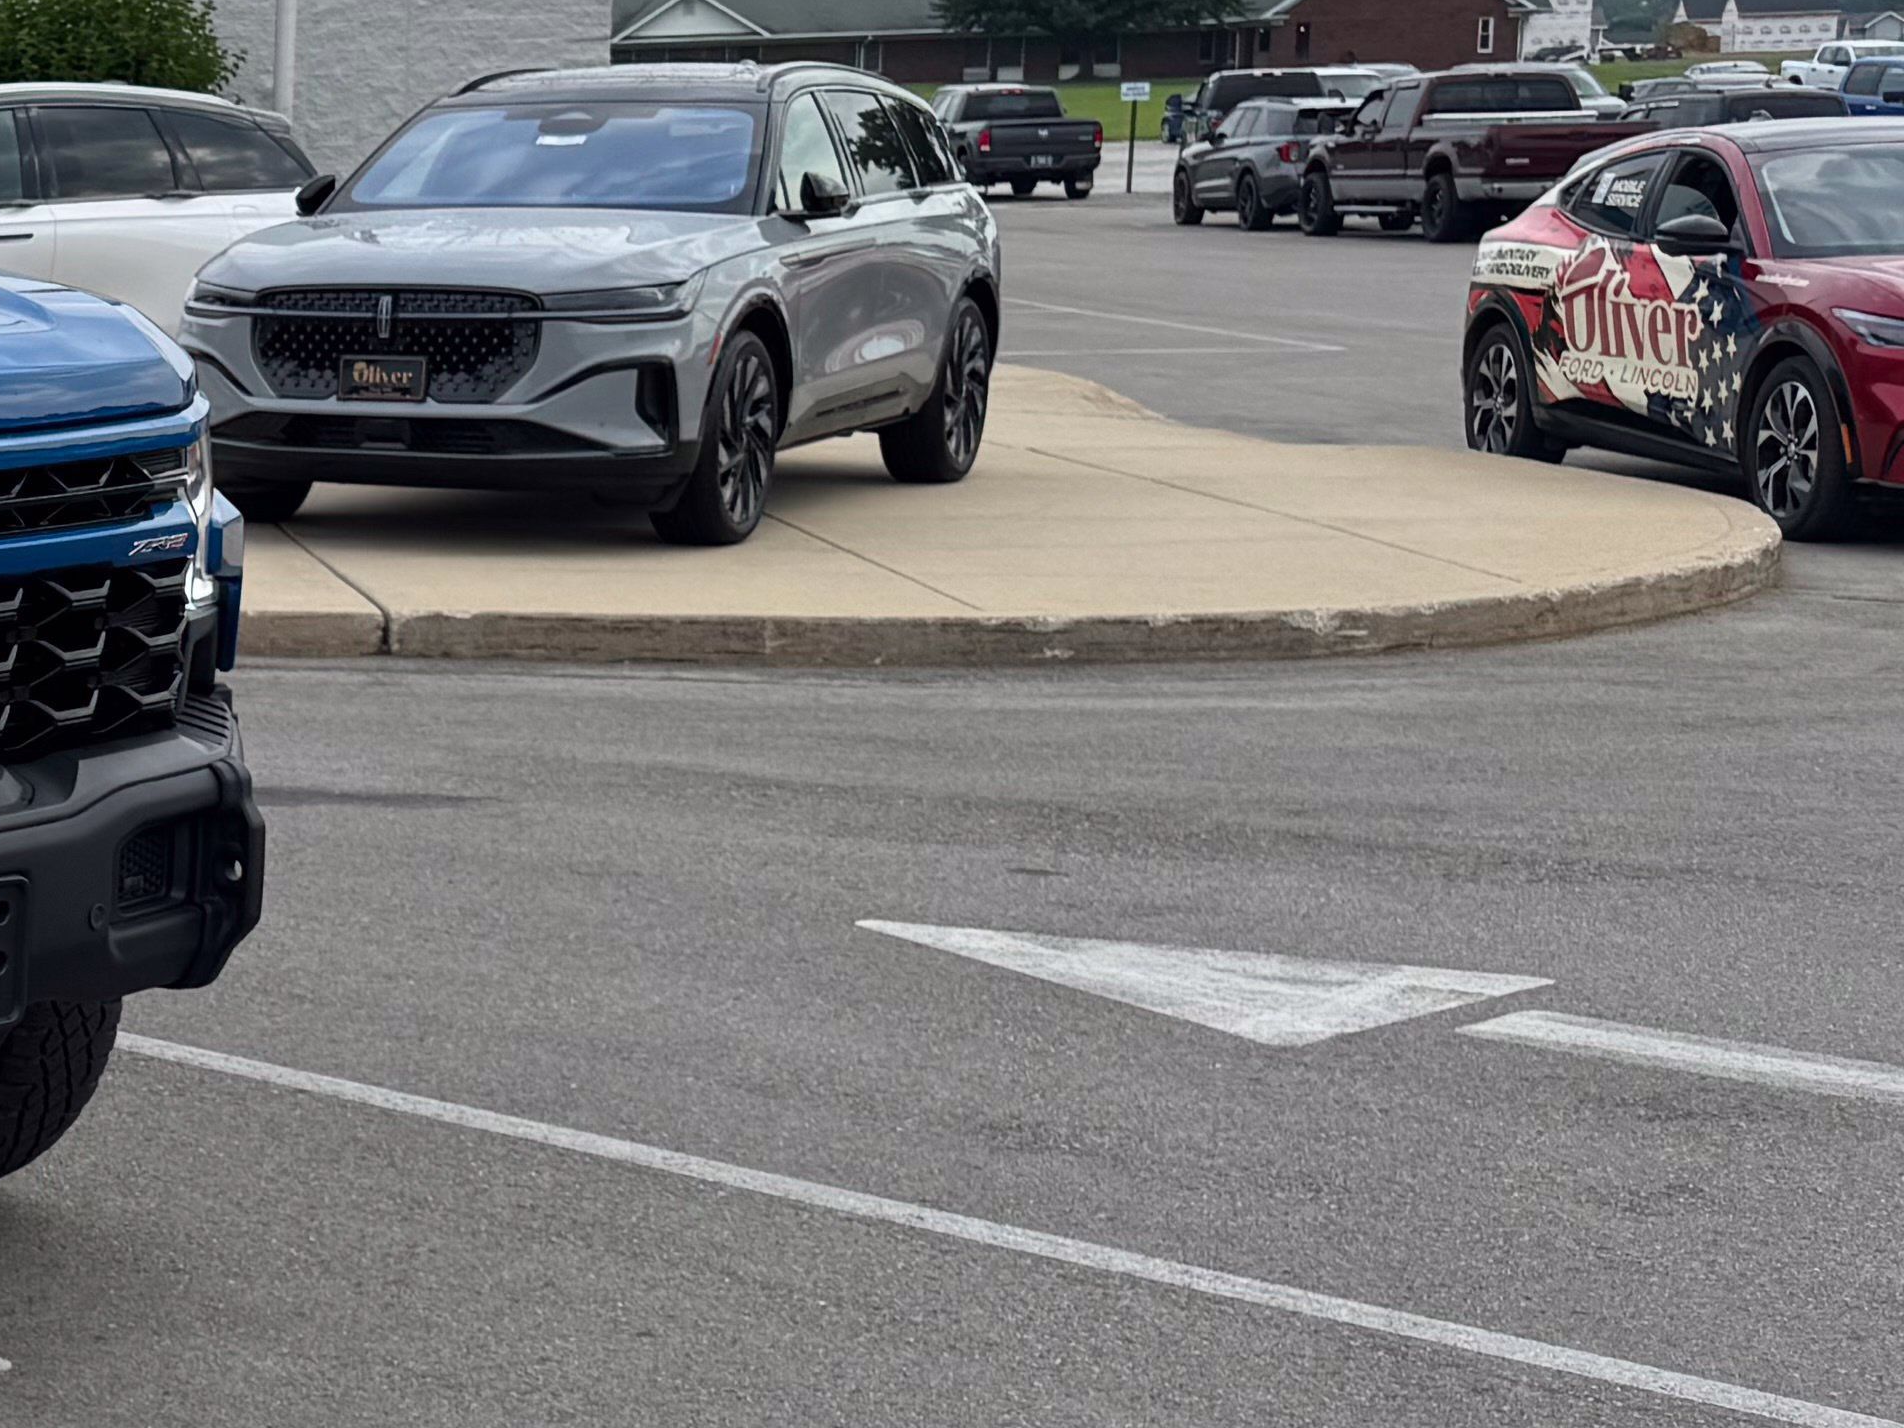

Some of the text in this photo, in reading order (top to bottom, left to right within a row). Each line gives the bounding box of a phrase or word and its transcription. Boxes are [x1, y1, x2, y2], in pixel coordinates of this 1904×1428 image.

[1557, 247, 1698, 368] Oliver
[352, 361, 413, 383] Oliver
[1559, 356, 1696, 393] FORD LINCOLN
